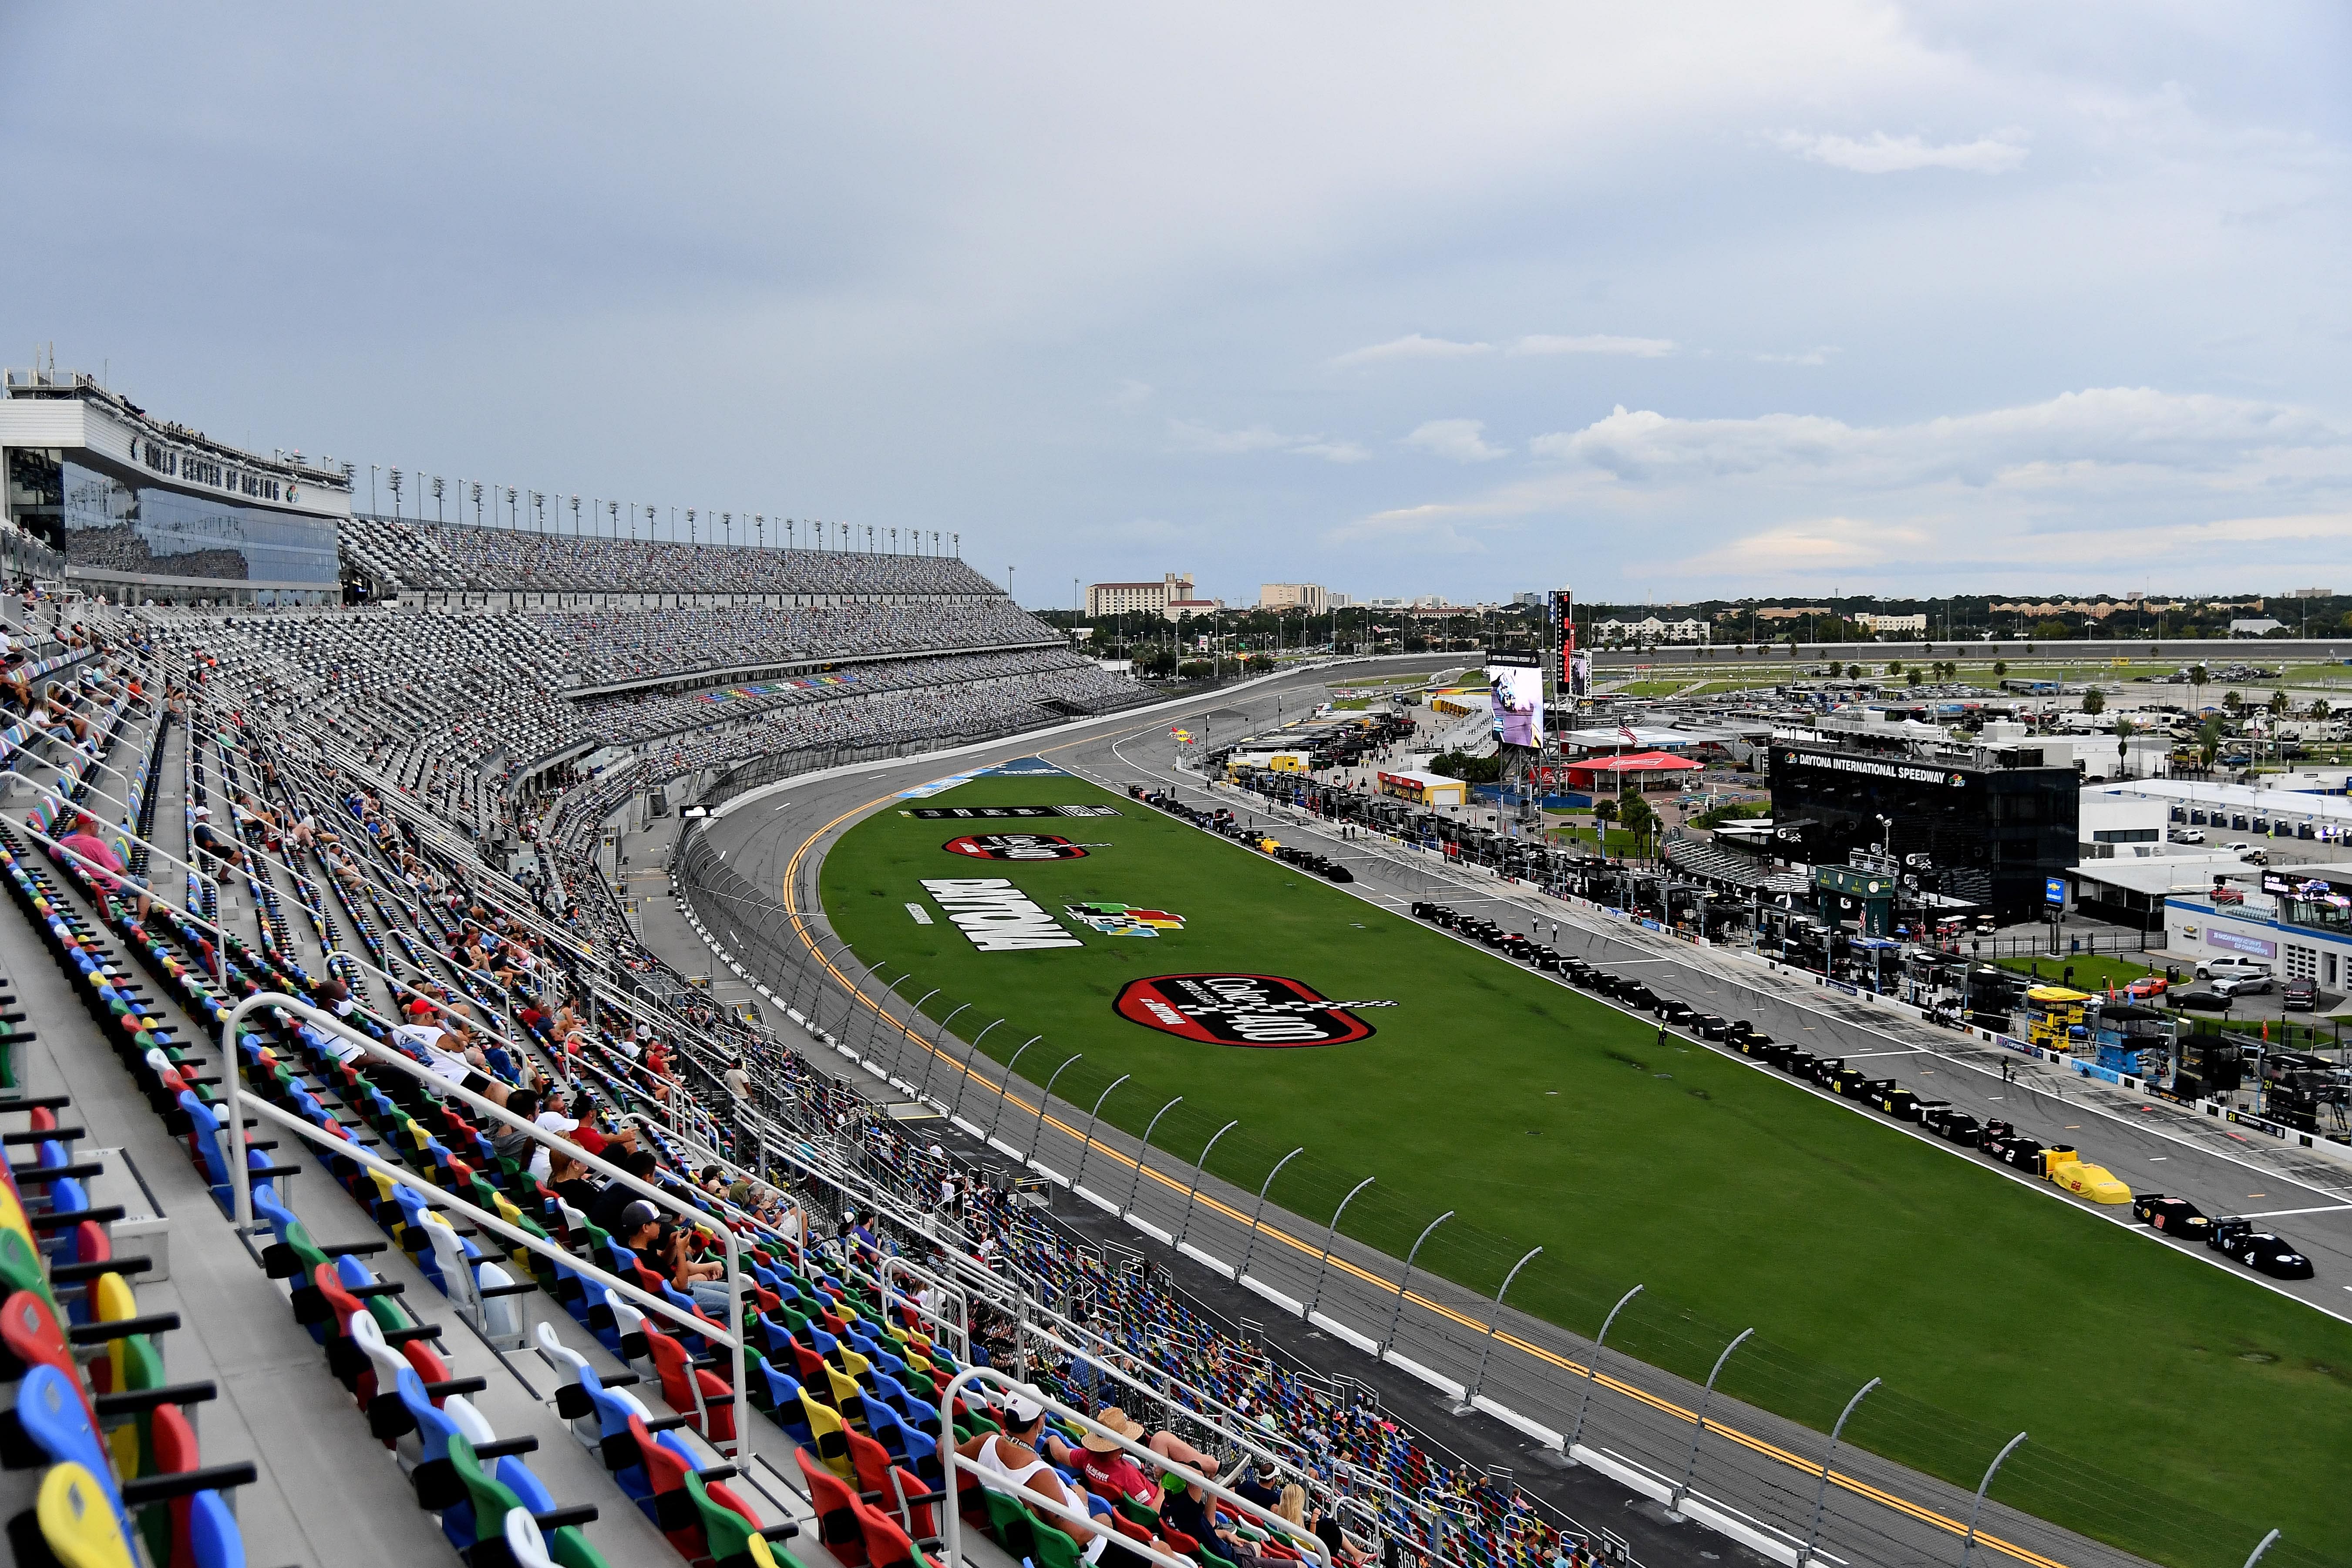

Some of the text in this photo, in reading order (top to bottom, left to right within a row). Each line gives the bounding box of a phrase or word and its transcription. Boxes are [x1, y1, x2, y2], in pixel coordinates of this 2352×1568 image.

[1800, 754, 1945, 784] DAYTONA INTERNATIONAL SPEEDWAY
[1412, 790, 1421, 800] UNOH
[1777, 828, 1786, 838] G
[1002, 835, 1041, 845] Coke
[1003, 847, 1060, 859] 400
[1906, 854, 1915, 865] G
[1840, 898, 1851, 909] G
[918, 878, 1086, 951] DAYTONA
[1203, 978, 1270, 1003] Coke
[1190, 990, 1221, 1006] SUGAR
[1148, 1002, 1186, 1025] DAYTONA
[1225, 1015, 1329, 1041] 400
[1699, 1026, 1703, 1037] 11
[1742, 1044, 1749, 1053] 12
[1833, 1080, 1841, 1093] 48
[2264, 1080, 2272, 1089] 21
[2274, 1084, 2293, 1094] MENARDS
[1884, 1100, 1891, 1113] 24
[2228, 1112, 2235, 1122] 21
[2238, 1116, 2261, 1127] MENARDS
[2005, 1150, 2016, 1162] 2
[2071, 1180, 2082, 1191] 22
[2244, 1252, 2255, 1265] 4
[1086, 1463, 1110, 1481] REMEMBER
[1397, 1547, 1416, 1568] 369
